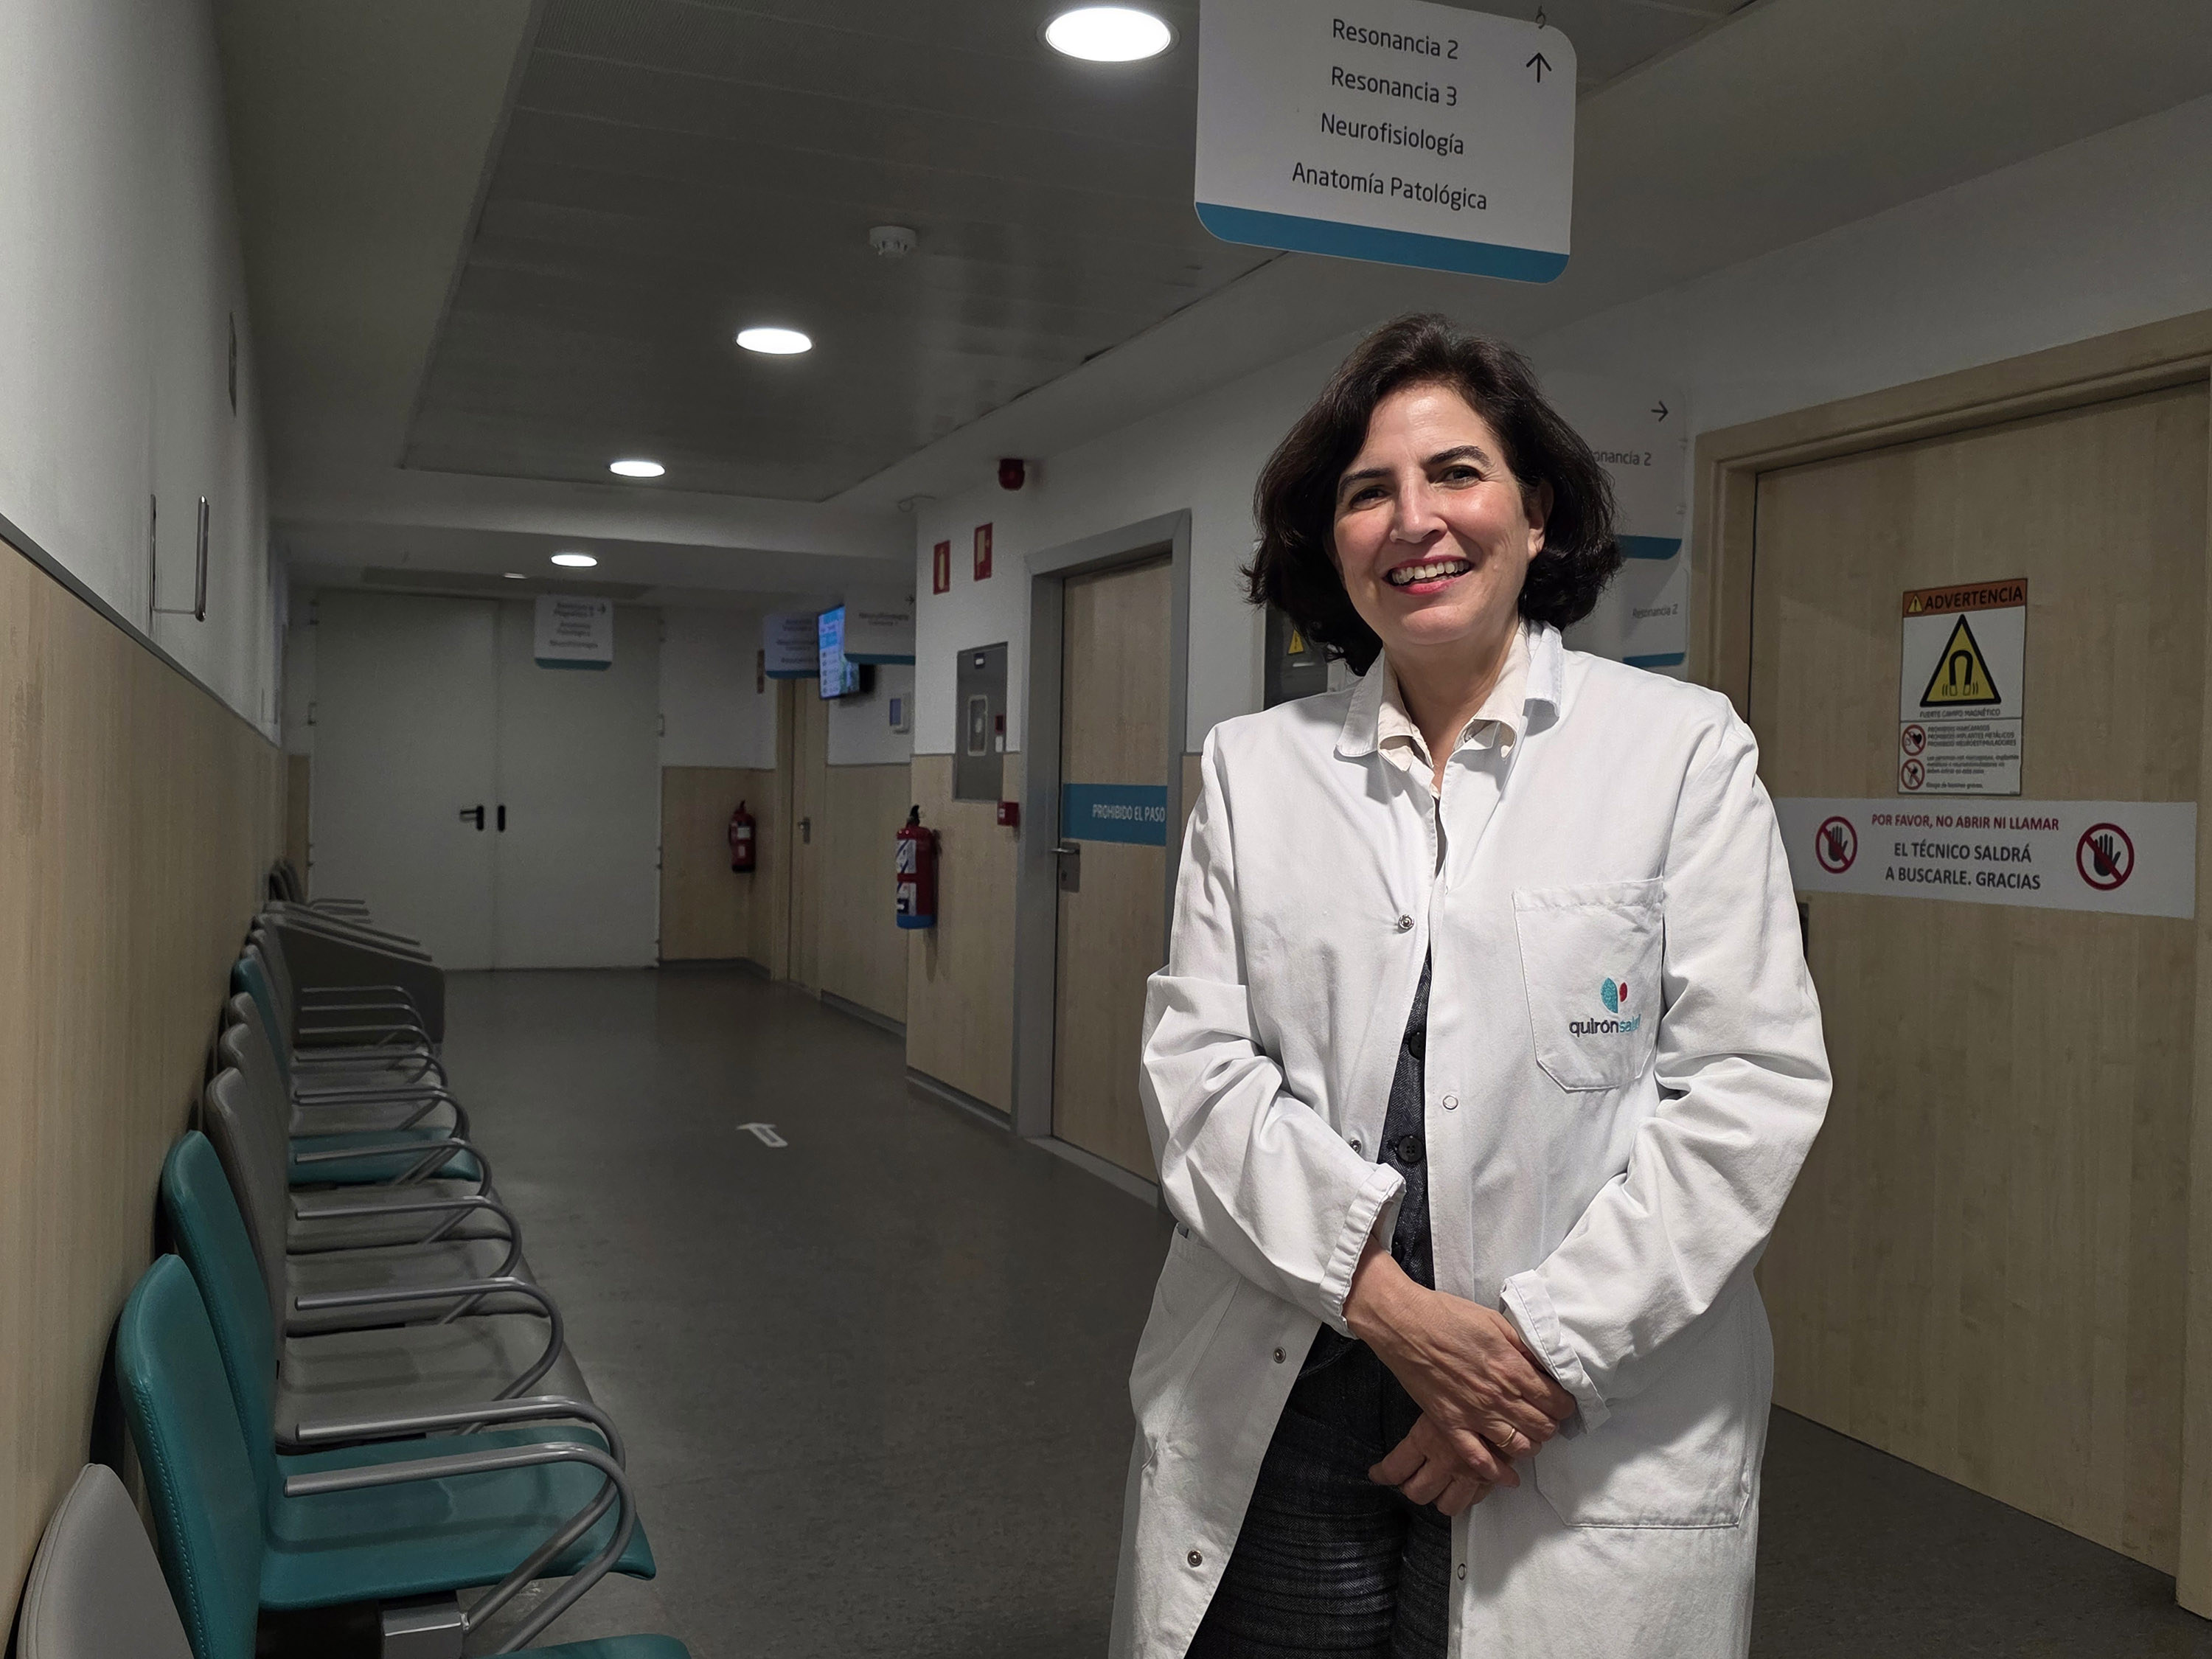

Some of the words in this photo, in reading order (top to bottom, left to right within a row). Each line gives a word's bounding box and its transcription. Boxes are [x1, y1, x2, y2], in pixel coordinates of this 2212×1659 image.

[1332, 18, 1441, 58] Resonancia
[1447, 39, 1458, 60] 2
[1332, 66, 1439, 104] Resonancia
[1446, 86, 1457, 107] 3
[1321, 112, 1464, 156] Neurofisiología
[1292, 162, 1384, 195] Anatomía
[1391, 176, 1486, 212] Patológica
[1590, 450, 1640, 466] onancia
[1643, 451, 1652, 467] 2
[1672, 603, 1678, 615] 2
[1924, 585, 2023, 611] ADVERTENCIA
[1964, 707, 2001, 717] MAGNÉTICO
[1092, 803, 1133, 821] PROHIBIDO
[1133, 805, 1144, 822] EL
[1144, 806, 1166, 823] PASO
[1871, 814, 1892, 827] POR
[1895, 814, 1933, 830] FAVOR,
[1935, 815, 1953, 828] NO
[1955, 816, 1990, 830] ABRIR
[1993, 817, 2006, 830] NI
[2009, 817, 2059, 831] LLAMAR
[1894, 842, 1908, 857] EL
[1912, 839, 1970, 860] TÉCNICO
[1974, 844, 2032, 863] SALDRÁ
[1885, 866, 1895, 881] A
[1899, 867, 1972, 886] BUSCARLE.
[1975, 871, 2041, 890] GRACIAS
